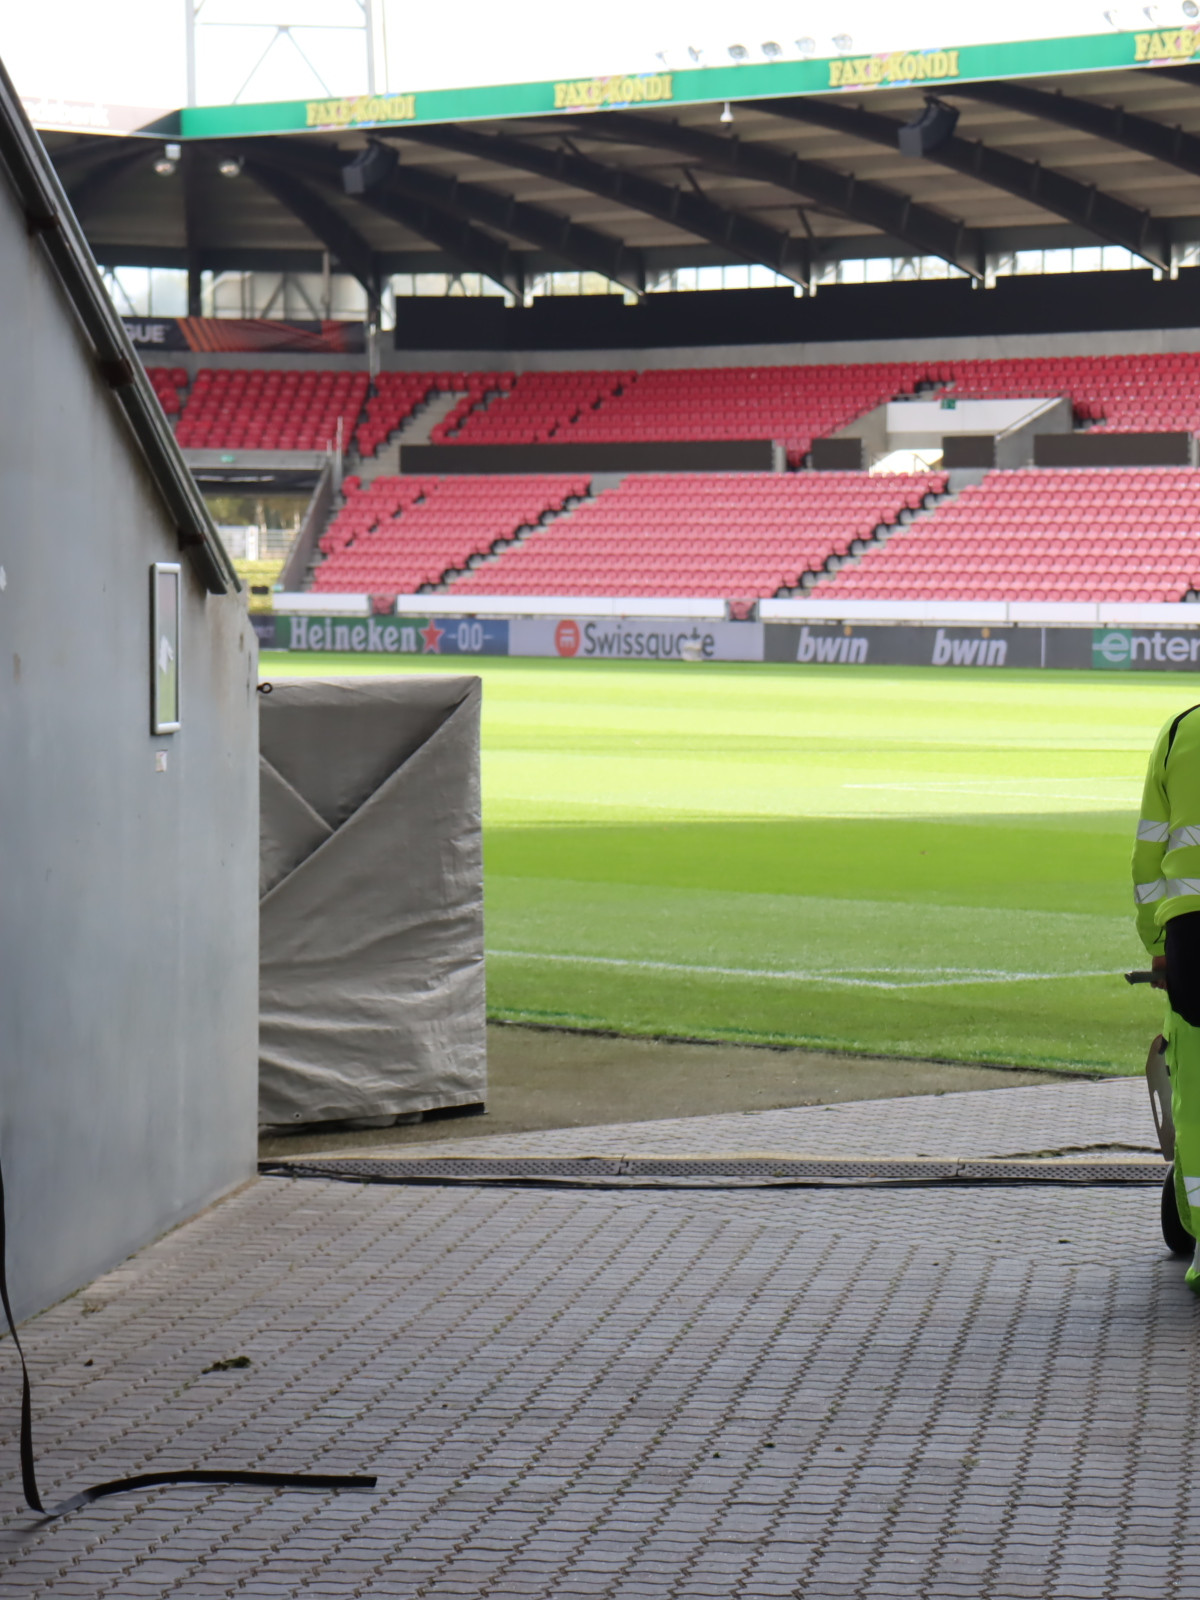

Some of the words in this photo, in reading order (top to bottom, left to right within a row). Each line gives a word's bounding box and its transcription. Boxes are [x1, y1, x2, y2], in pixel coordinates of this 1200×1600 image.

[1134, 29, 1194, 61] FAXE
[829, 58, 881, 87] FAXE
[887, 51, 959, 81] KONDI
[554, 81, 603, 108] FAXE
[607, 76, 673, 104] KONDI
[124, 323, 165, 343] GUE
[290, 617, 417, 651] Heineken
[797, 626, 868, 663] bwin
[931, 628, 1008, 666] bwin
